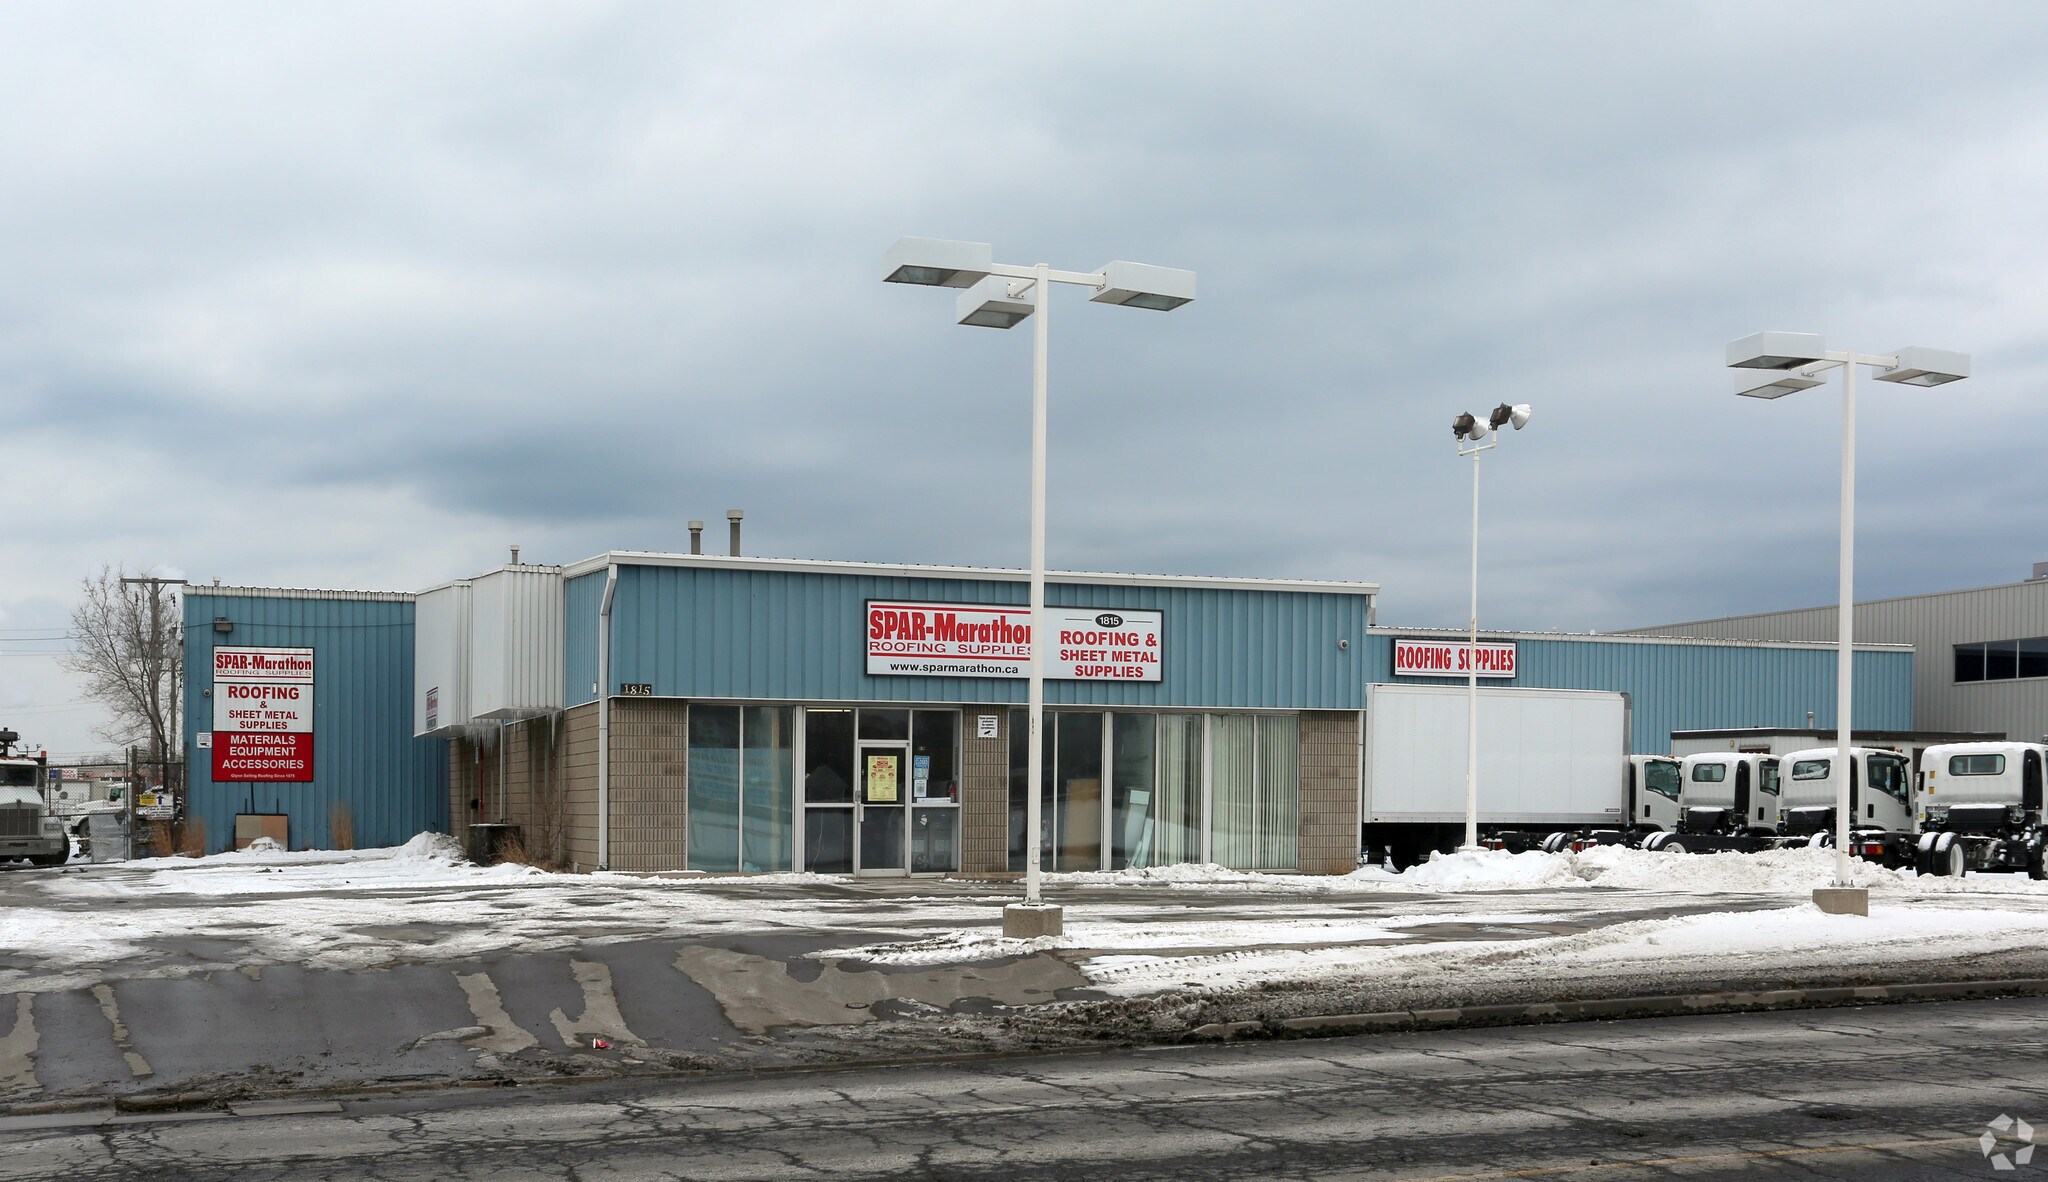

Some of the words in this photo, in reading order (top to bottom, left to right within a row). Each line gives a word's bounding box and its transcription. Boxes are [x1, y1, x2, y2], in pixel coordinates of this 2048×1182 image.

[1099, 616, 1119, 625] 1815
[1060, 630, 1139, 646] ROOFING
[1145, 632, 1157, 647] &
[869, 641, 946, 653] ROOFING
[958, 644, 1031, 655] SUPPLIE
[1060, 649, 1107, 662] SHEET
[1111, 650, 1158, 663] METAL
[1397, 646, 1452, 670] ROOFING
[215, 654, 311, 670] SPAR-Marathon
[890, 663, 1019, 674] www.sparmarathon.ca
[1074, 664, 1144, 678] SUPPLIES
[228, 685, 299, 700] ROOFING
[624, 684, 651, 695] 1815
[260, 700, 267, 709] &
[228, 710, 262, 719] SHEET
[264, 710, 298, 720] METAL
[239, 720, 288, 730] SUPPLIES
[230, 735, 296, 745] MATERIALS
[229, 746, 297, 756] EQUIPMENT
[222, 759, 304, 769] ACCESSORIES
